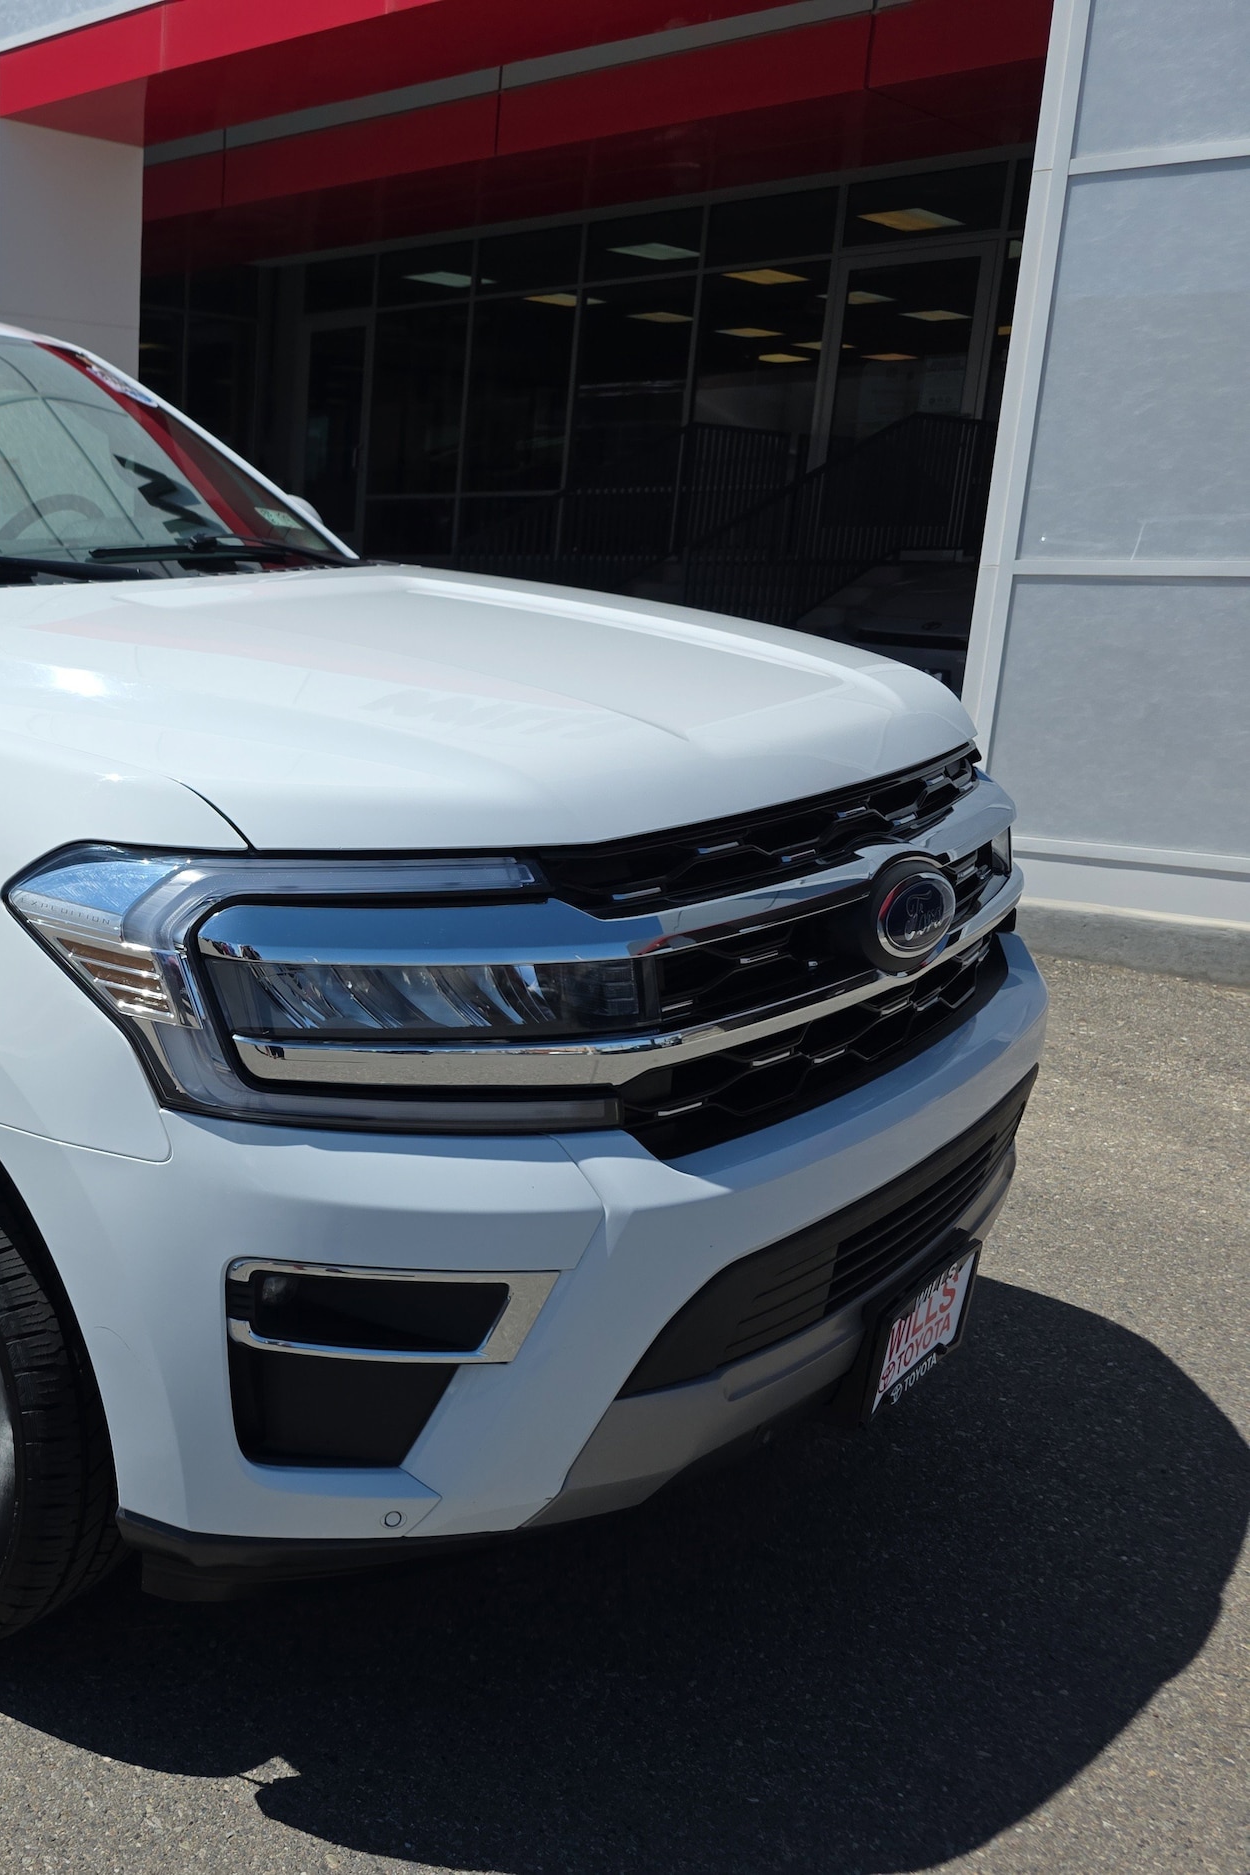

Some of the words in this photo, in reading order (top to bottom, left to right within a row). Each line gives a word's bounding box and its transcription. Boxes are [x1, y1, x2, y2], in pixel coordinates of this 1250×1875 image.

[905, 890, 944, 941] Ford
[915, 1262, 958, 1305] WILLS
[888, 1272, 959, 1362] WILLS
[897, 1312, 951, 1375] TOYOTA
[903, 1352, 938, 1392] TOYOTA
